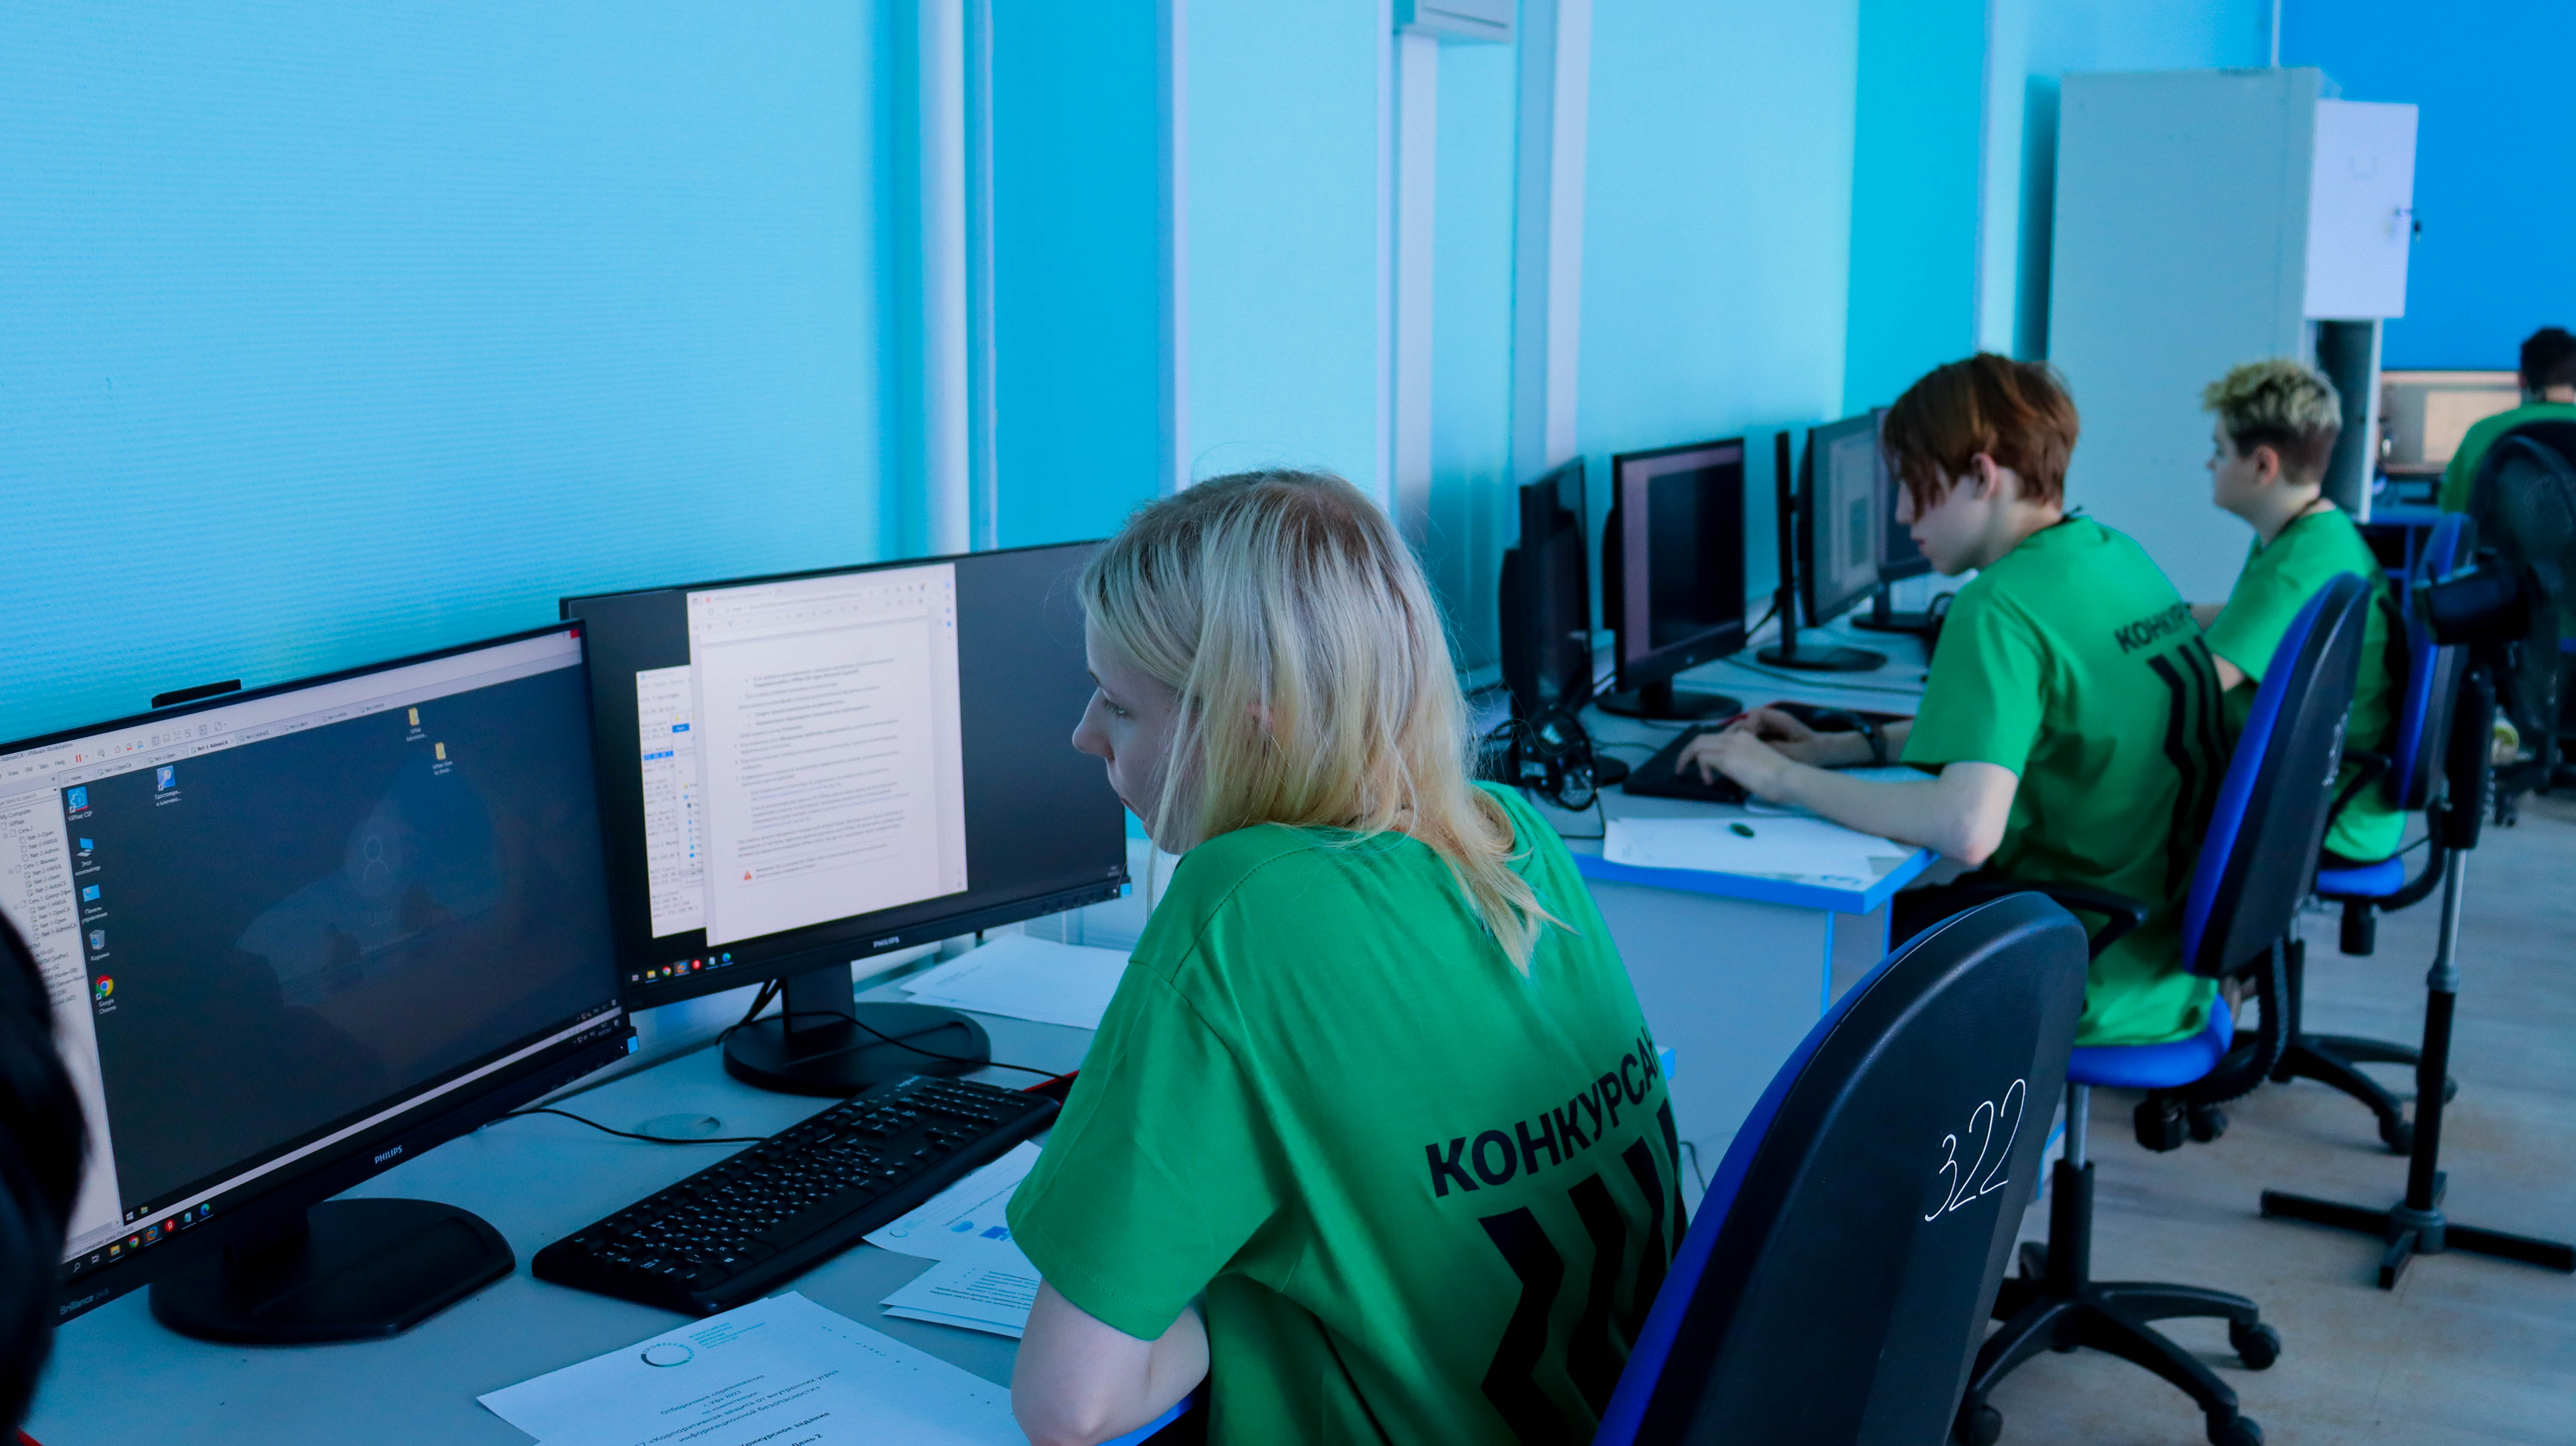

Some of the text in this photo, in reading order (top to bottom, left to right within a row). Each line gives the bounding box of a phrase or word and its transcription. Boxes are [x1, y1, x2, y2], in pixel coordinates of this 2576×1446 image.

[47, 743, 73, 752] Workstation
[8, 809, 31, 818] Computer
[85, 906, 102, 914] Панель
[873, 936, 900, 948] PHILIPS
[91, 952, 110, 962] Корзина
[99, 998, 115, 1008] Google
[99, 1005, 117, 1015] Chrome
[374, 1145, 403, 1164] PHILIPS
[1925, 1078, 2025, 1221] 322
[60, 1294, 94, 1316] Brilliance
[660, 1374, 766, 1416] Отборочные соревнования
[711, 1397, 724, 1405] Уфа
[724, 1390, 742, 1399] 2023
[649, 1414, 723, 1443] «Корпоративная
[723, 1401, 755, 1416] защита
[766, 1378, 817, 1399] внутренних
[817, 1370, 840, 1381] угроз
[678, 1385, 821, 1443] информационной безопасности»
[793, 1411, 831, 1429] задание
[792, 1436, 816, 1446] День
